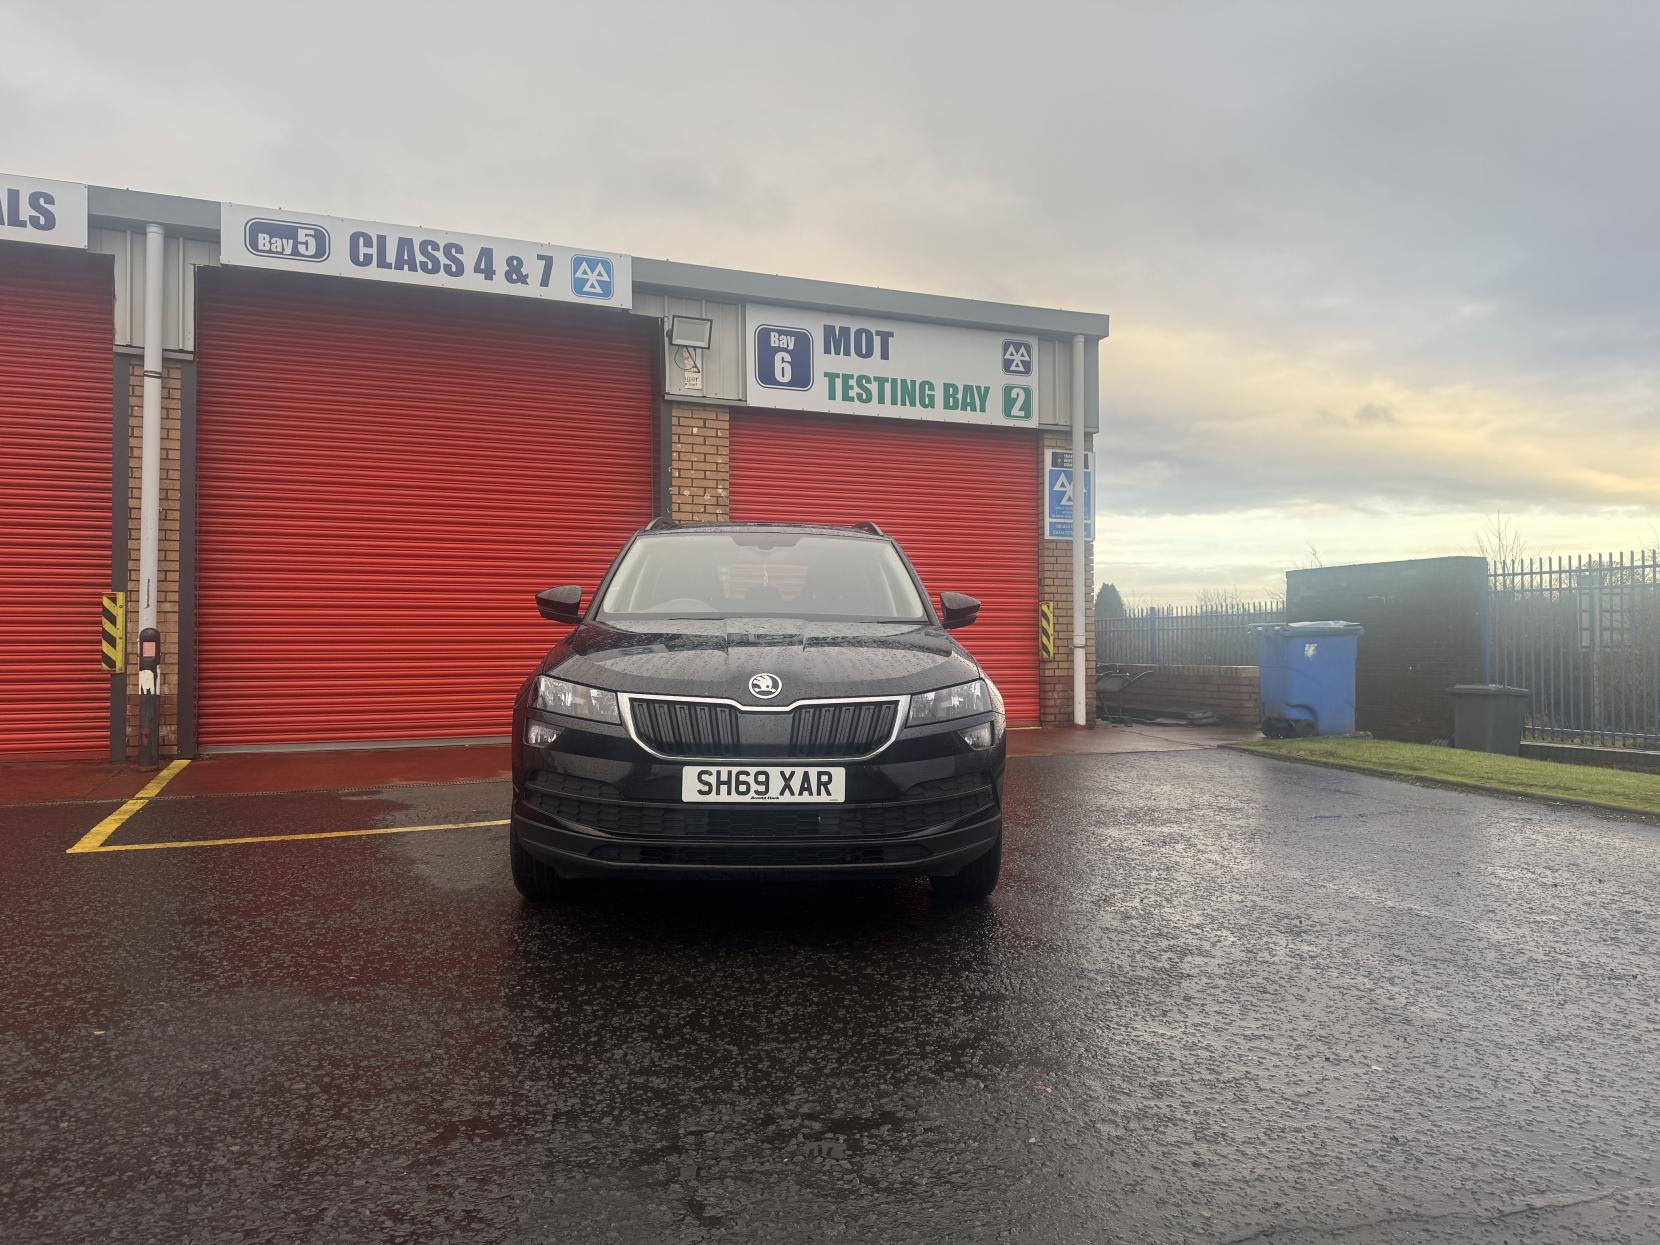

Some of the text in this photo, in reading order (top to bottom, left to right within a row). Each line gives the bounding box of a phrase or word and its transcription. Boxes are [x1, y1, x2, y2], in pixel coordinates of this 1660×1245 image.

[258, 228, 317, 256] Bay 5
[349, 231, 554, 287] CLASS 4 & 7
[770, 331, 795, 349] Bay
[823, 324, 895, 361] MOT
[774, 351, 792, 383] 6
[823, 371, 991, 413] TESTING BAY
[1009, 389, 1026, 417] 2
[696, 769, 833, 797] SH69 XAR
